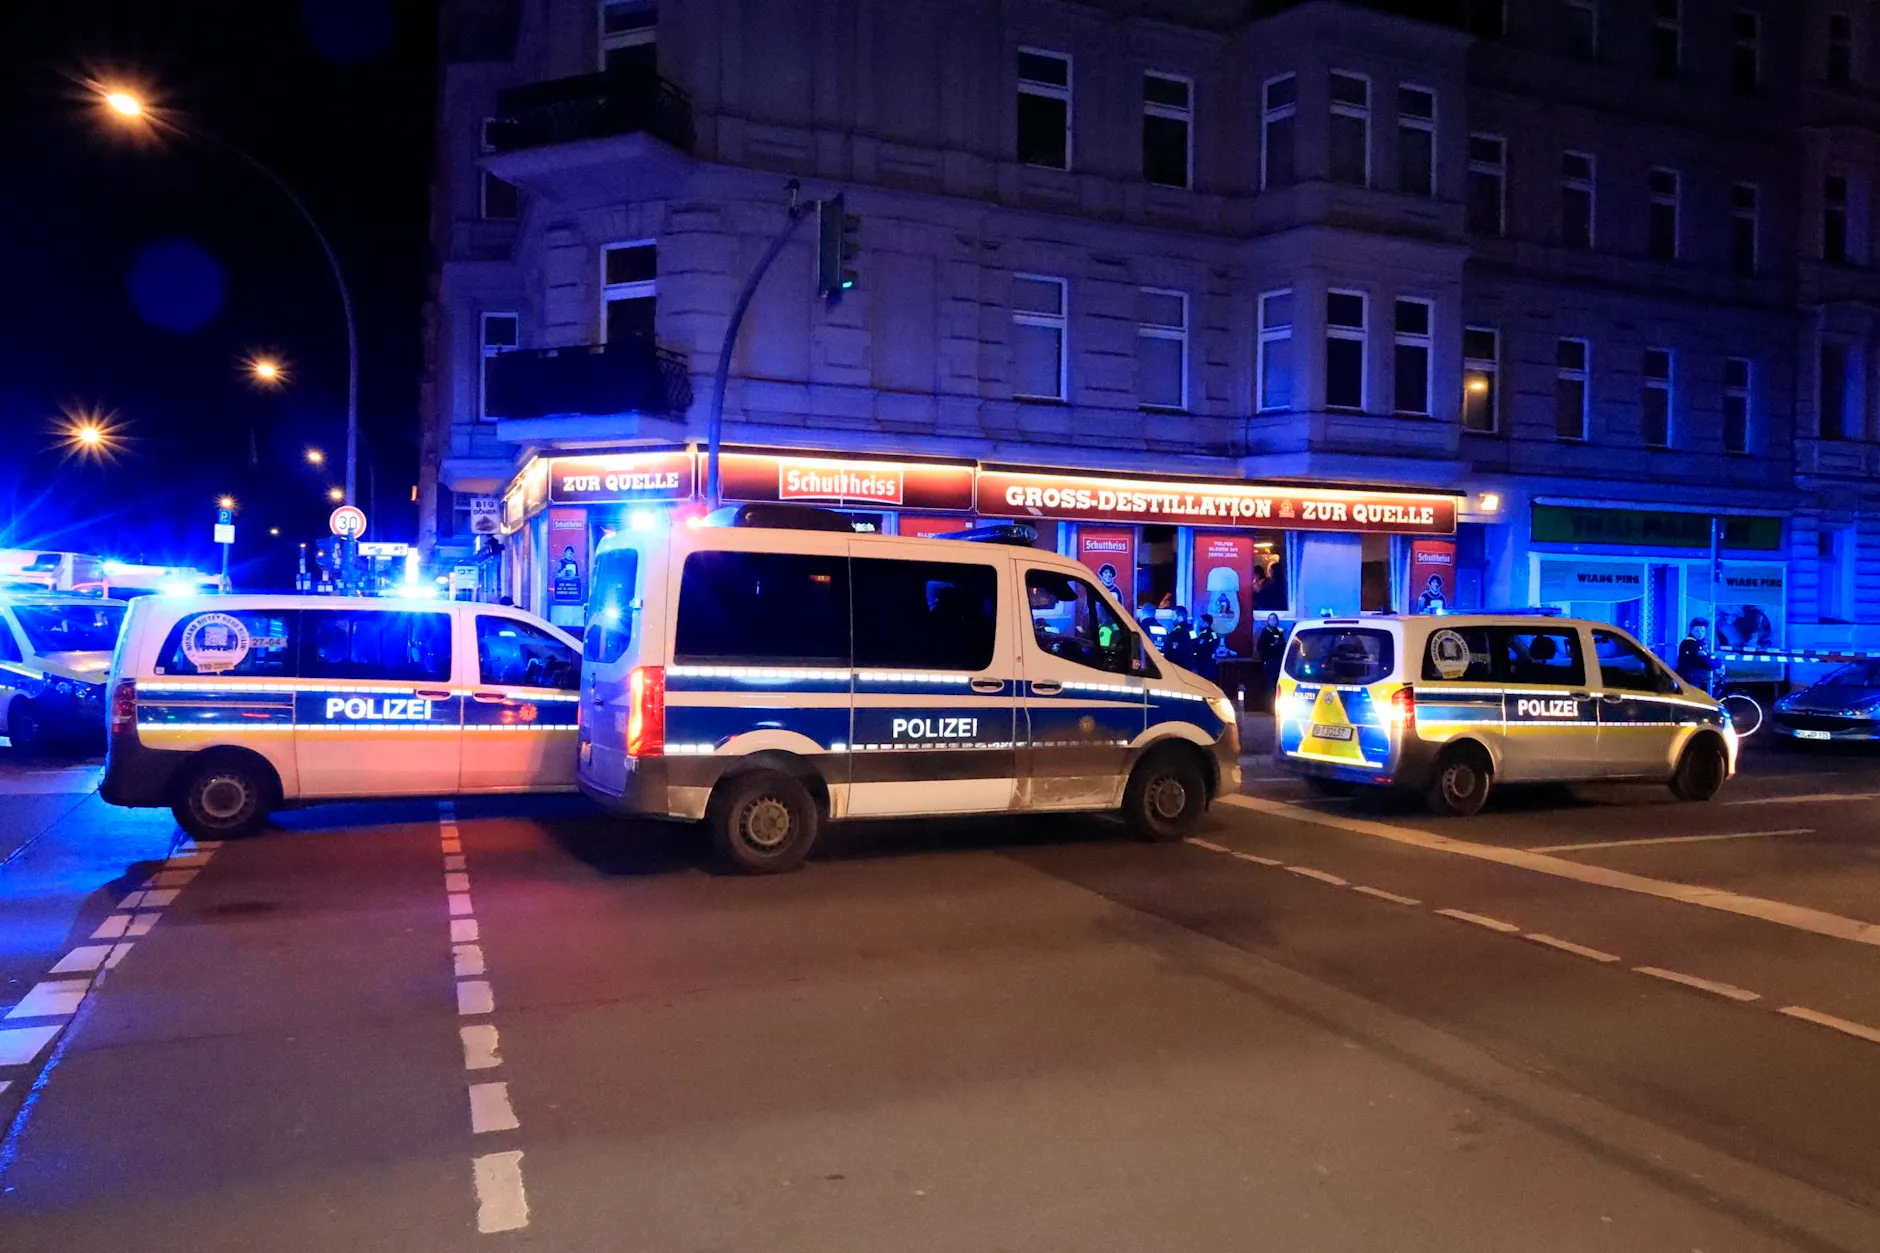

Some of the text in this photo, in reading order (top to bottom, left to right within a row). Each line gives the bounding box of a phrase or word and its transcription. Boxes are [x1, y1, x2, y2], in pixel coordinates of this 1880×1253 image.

[563, 472, 679, 492] ZUR QUELLE
[787, 470, 896, 497] Schultheiss
[1005, 486, 1434, 524] GROSS-DESTILLATION ZUR QUELLE
[339, 516, 358, 530] 30
[1086, 540, 1126, 550] Schultheiss
[1577, 573, 1640, 584] WIANG PING
[1726, 578, 1782, 588] WIANG PING
[326, 698, 432, 720] POLIZEI
[1517, 699, 1579, 717] POLIZEI
[893, 718, 978, 738] POLIZEI
